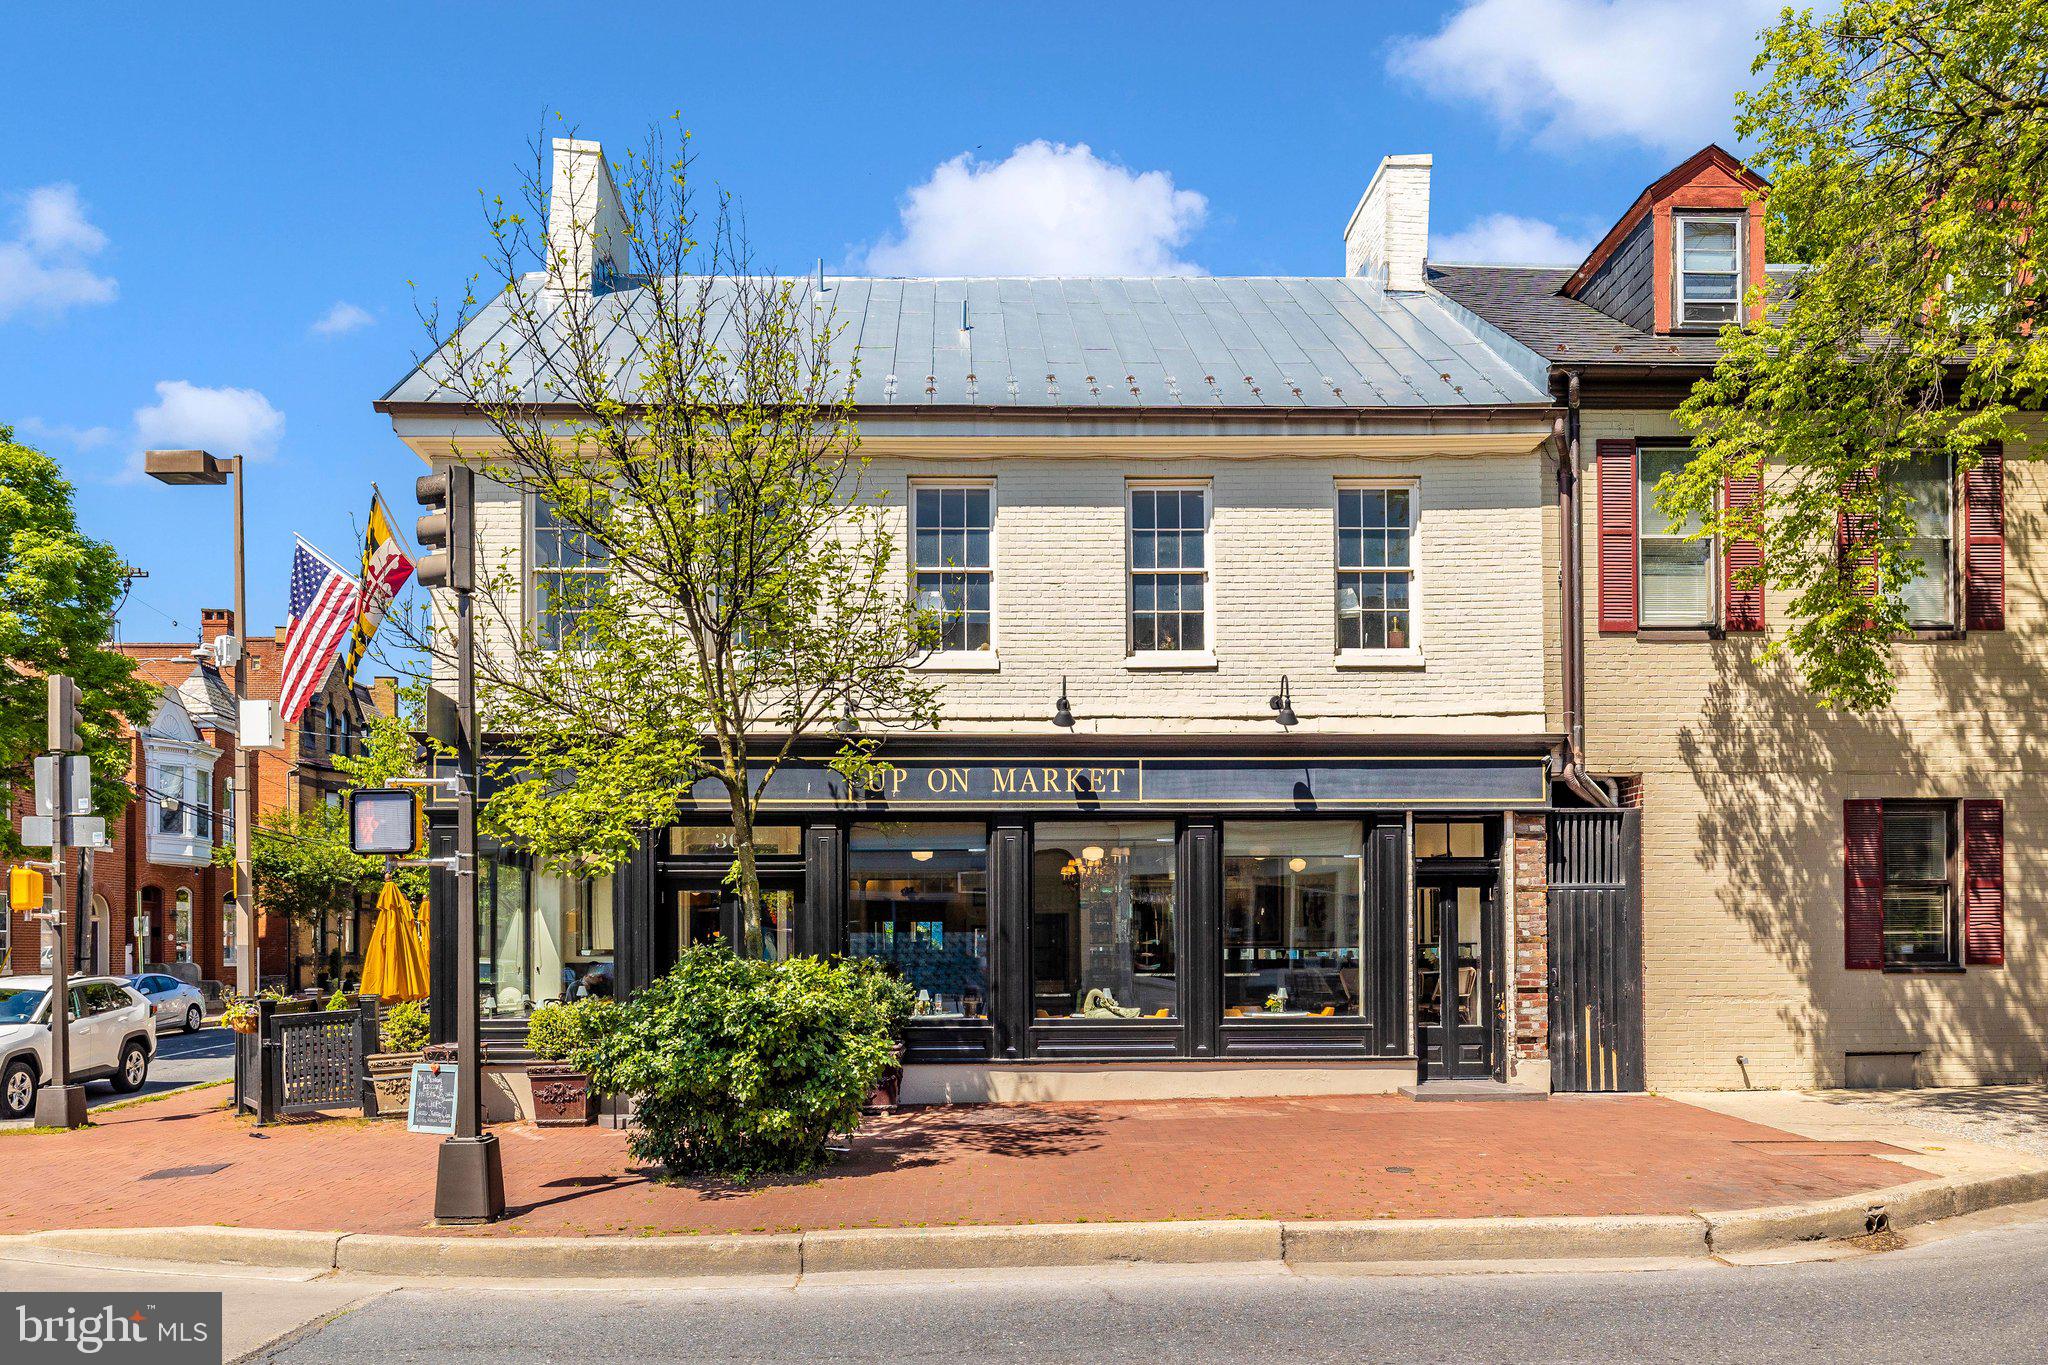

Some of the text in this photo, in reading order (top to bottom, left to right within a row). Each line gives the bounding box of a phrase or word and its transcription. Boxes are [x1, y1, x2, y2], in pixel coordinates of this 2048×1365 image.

[867, 768, 1125, 793] UP ON MARKET
